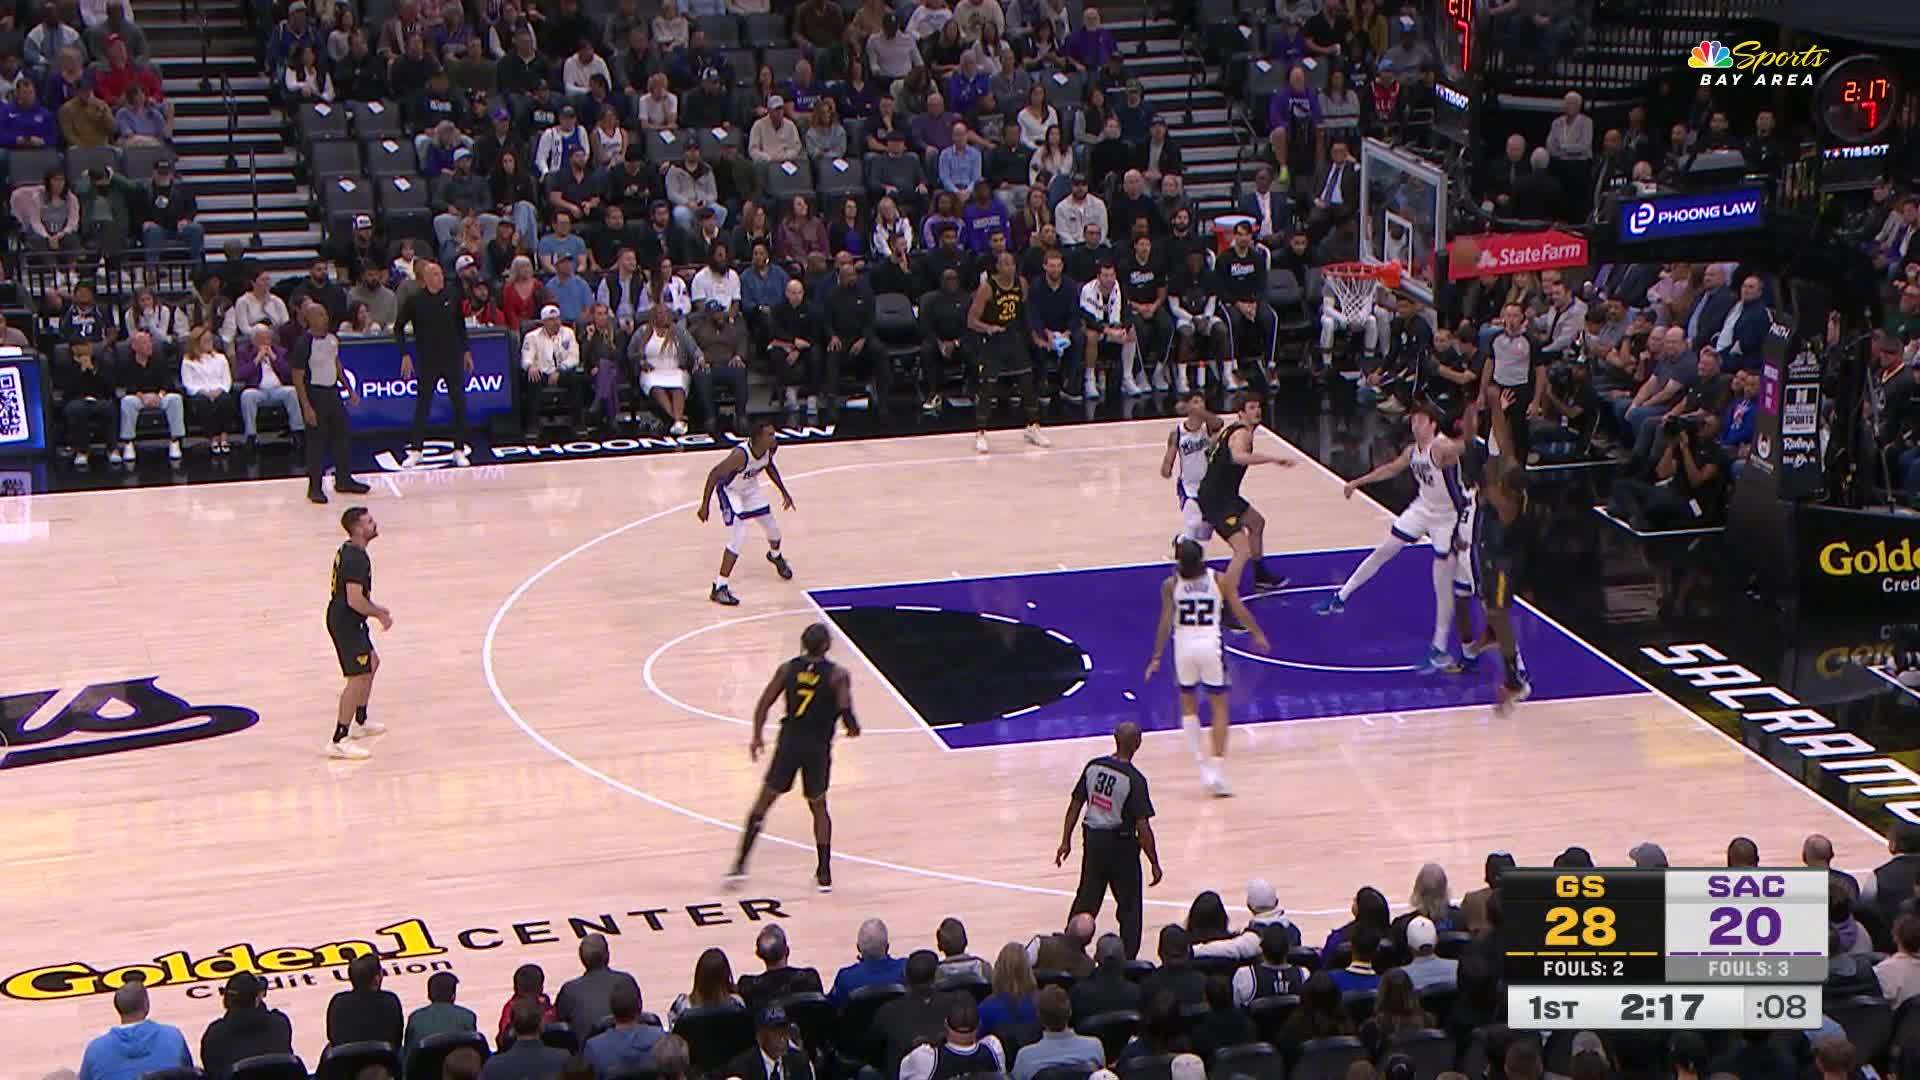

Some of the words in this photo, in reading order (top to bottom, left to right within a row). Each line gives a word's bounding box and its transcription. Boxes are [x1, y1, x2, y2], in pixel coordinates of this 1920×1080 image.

[1843, 79, 1887, 102] 2:17
[1861, 101, 1877, 129] 7
[1657, 206, 1720, 224] PHOONG
[1722, 201, 1757, 216] LAW
[1002, 301, 1016, 315] 20
[491, 433, 715, 459] PHOONG
[1179, 599, 1214, 625] 22
[795, 689, 815, 716] 7
[1095, 772, 1117, 798] 38
[457, 899, 791, 950] CENTER
